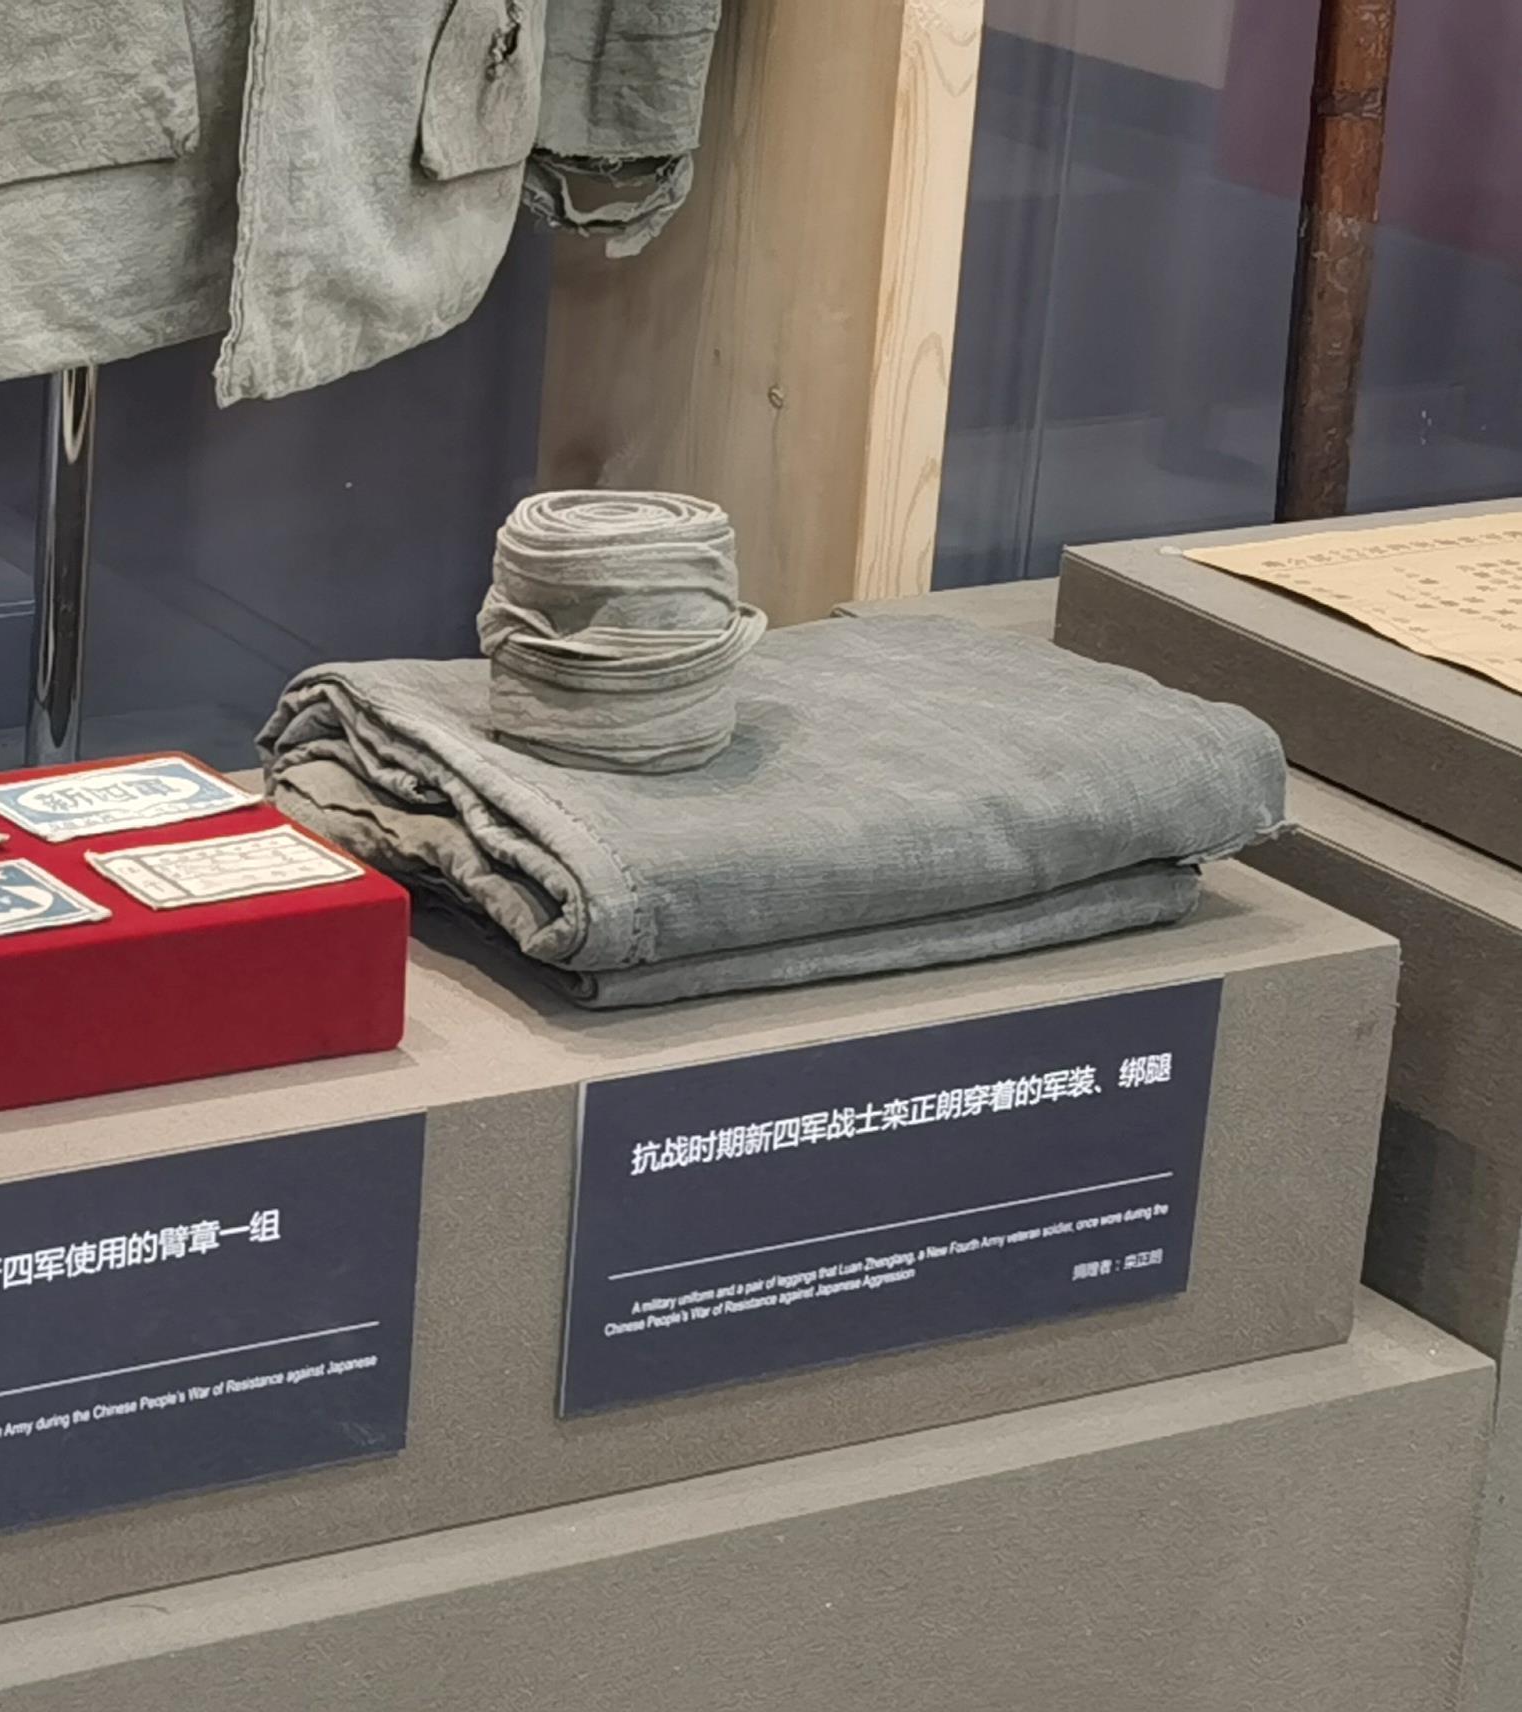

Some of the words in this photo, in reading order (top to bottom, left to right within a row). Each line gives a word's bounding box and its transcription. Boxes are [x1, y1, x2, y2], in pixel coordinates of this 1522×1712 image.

[641, 1297, 677, 1313] military
[678, 1289, 715, 1307] uniform
[716, 1284, 736, 1299] and
[745, 1280, 765, 1295] pair
[777, 1271, 818, 1288] leggings
[819, 1265, 837, 1279] that
[838, 1262, 864, 1275] Luan
[926, 1247, 948, 1258] New
[949, 1239, 981, 1254] Fourth
[981, 1236, 1005, 1247] Army
[1007, 1228, 1041, 1243] veteran
[1076, 1218, 1099, 1230] once
[1100, 1213, 1124, 1225] wore
[1124, 1207, 1154, 1221] during
[1154, 1204, 1168, 1215] the
[604, 1320, 645, 1336] Chinese
[647, 1309, 688, 1328] People's
[691, 1307, 711, 1319] War
[712, 1303, 723, 1316] of
[724, 1295, 777, 1313] Resistance
[779, 1288, 816, 1305] against
[816, 1281, 863, 1297] Japanese
[863, 1267, 916, 1289] Aggression
[4, 1422, 33, 1436] Army
[36, 1414, 70, 1430] during
[73, 1410, 90, 1423] the
[93, 1401, 137, 1419] Chinese
[140, 1391, 185, 1410] People's
[188, 1387, 210, 1400] War
[212, 1382, 224, 1396] of
[226, 1373, 284, 1393] Resistance
[286, 1364, 325, 1383] against
[327, 1356, 377, 1374] Japanese
